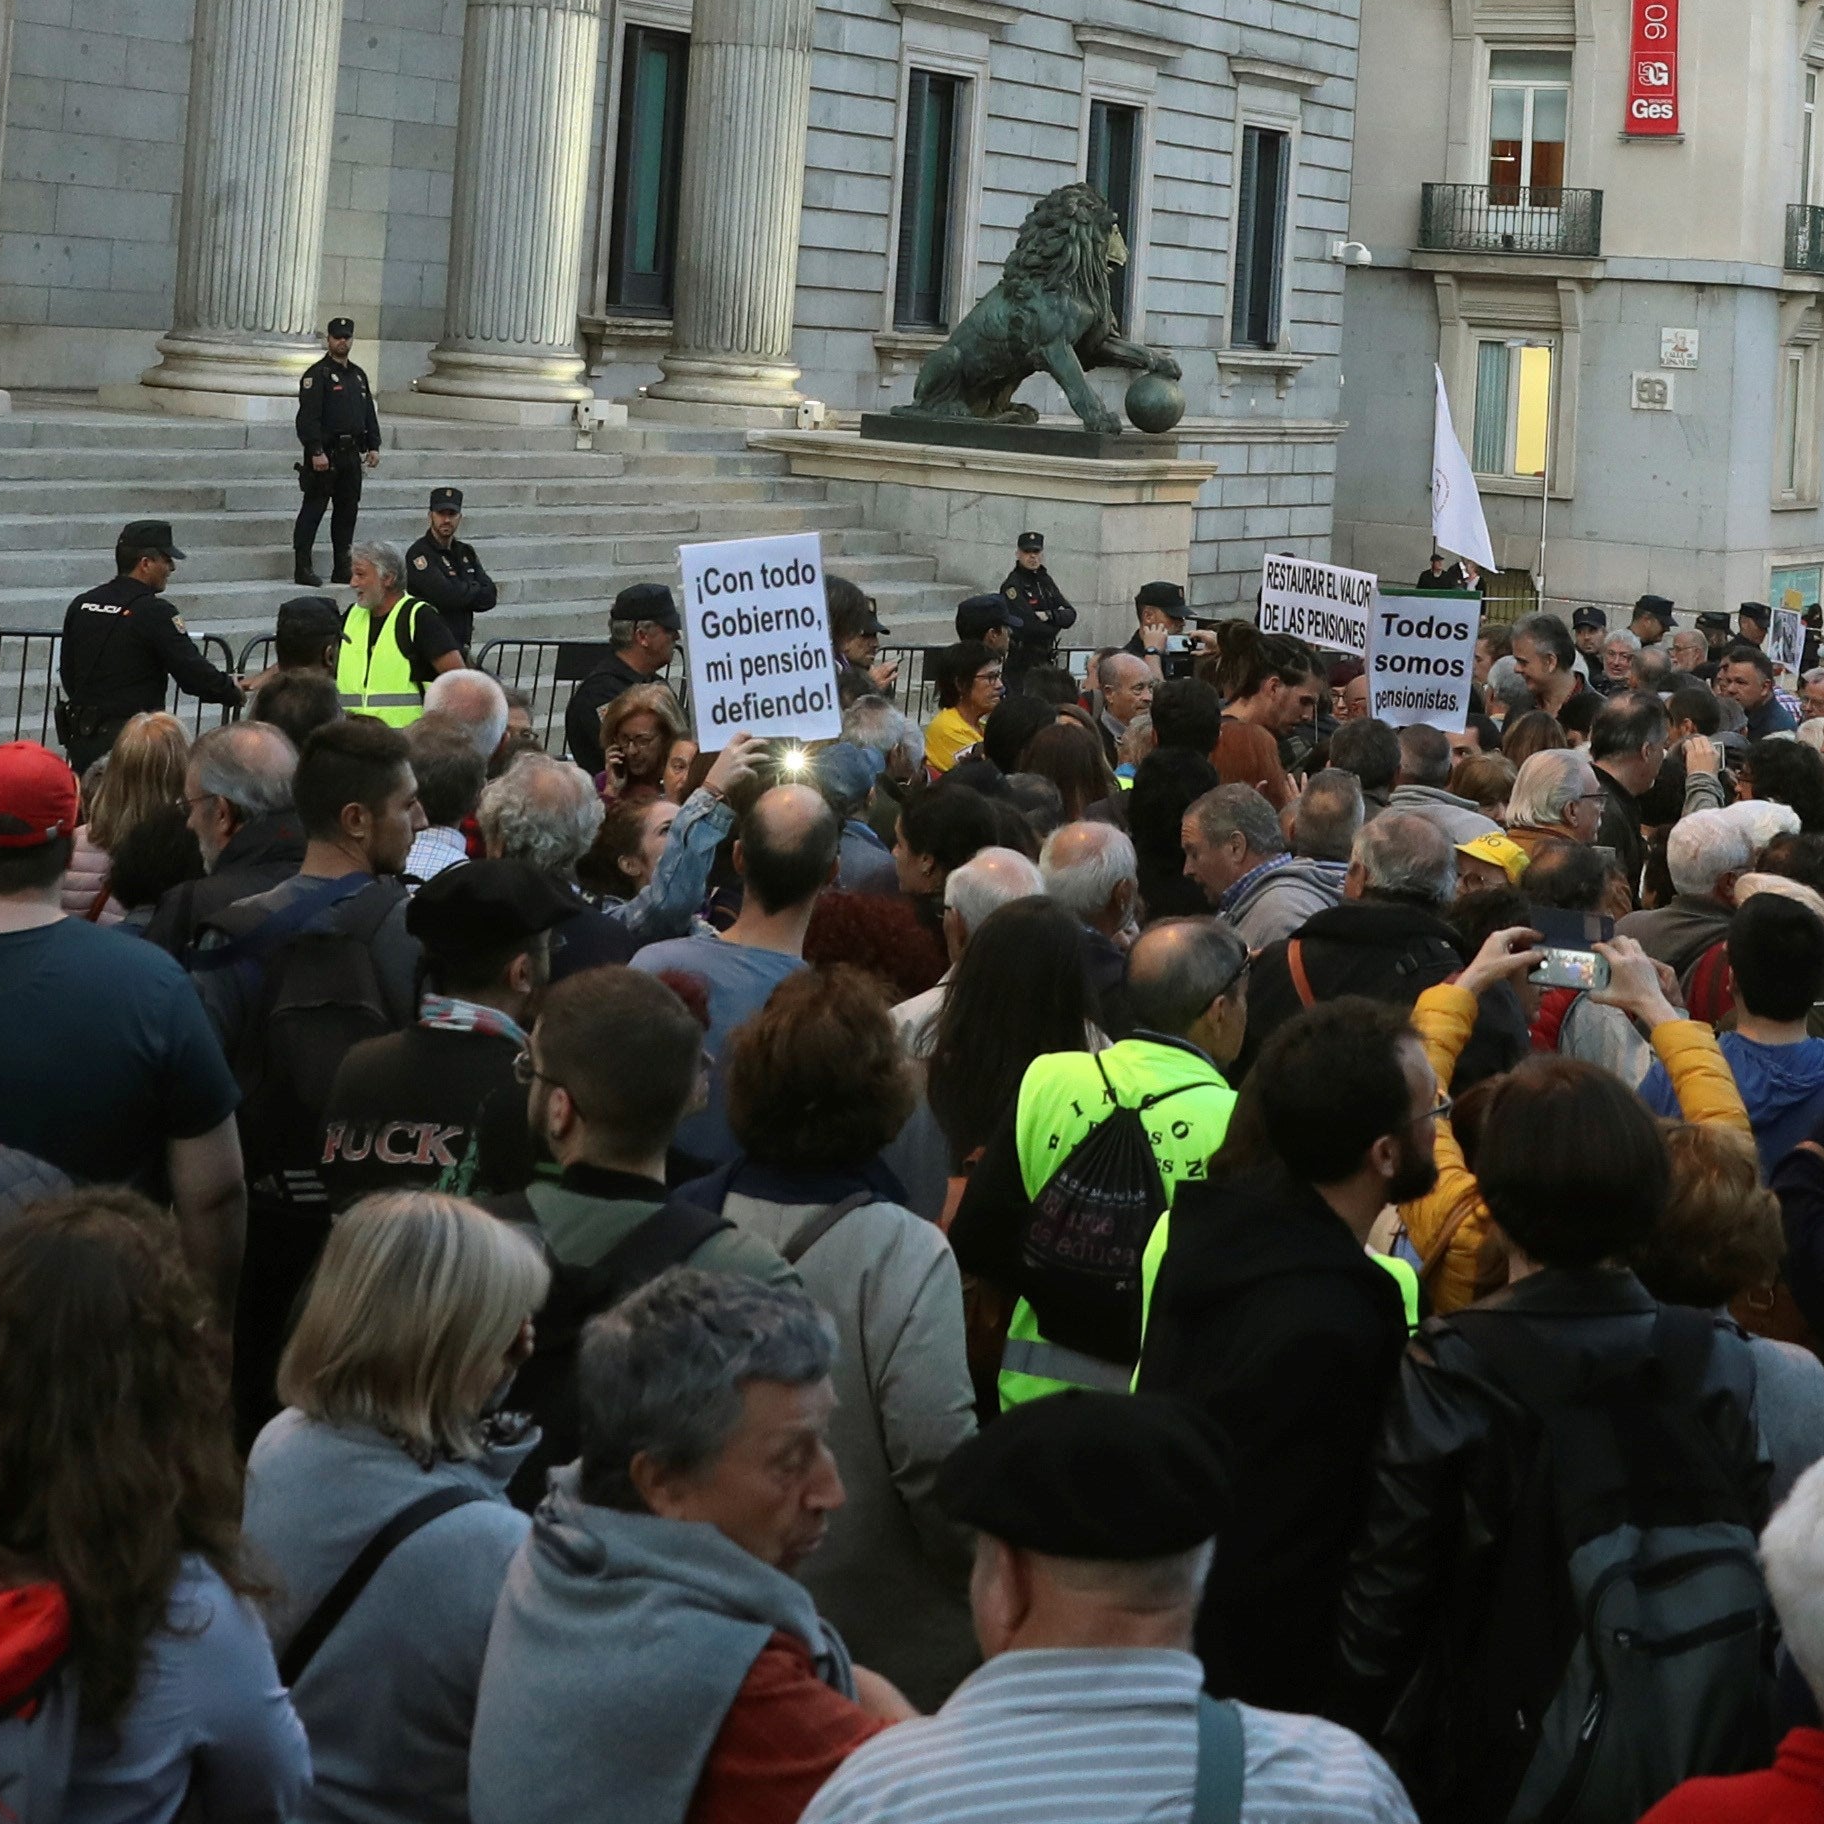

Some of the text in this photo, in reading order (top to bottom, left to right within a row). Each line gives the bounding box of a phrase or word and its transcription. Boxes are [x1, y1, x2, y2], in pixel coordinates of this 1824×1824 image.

[1644, 4, 1667, 40] 90
[1631, 98, 1673, 119] Ges
[696, 558, 816, 604] ¡Con todo
[1266, 561, 1371, 608] RESTAURAR EL VALOR
[701, 606, 822, 639] Gobierno,
[1264, 604, 1366, 649] DE LAS PENSIONES
[1381, 613, 1469, 641] Todos
[706, 642, 827, 685] mi pensión
[1375, 654, 1464, 677] somos
[712, 683, 832, 725] defiendo!
[1375, 686, 1459, 715] pensionistas.
[321, 1121, 464, 1166] FUCK
